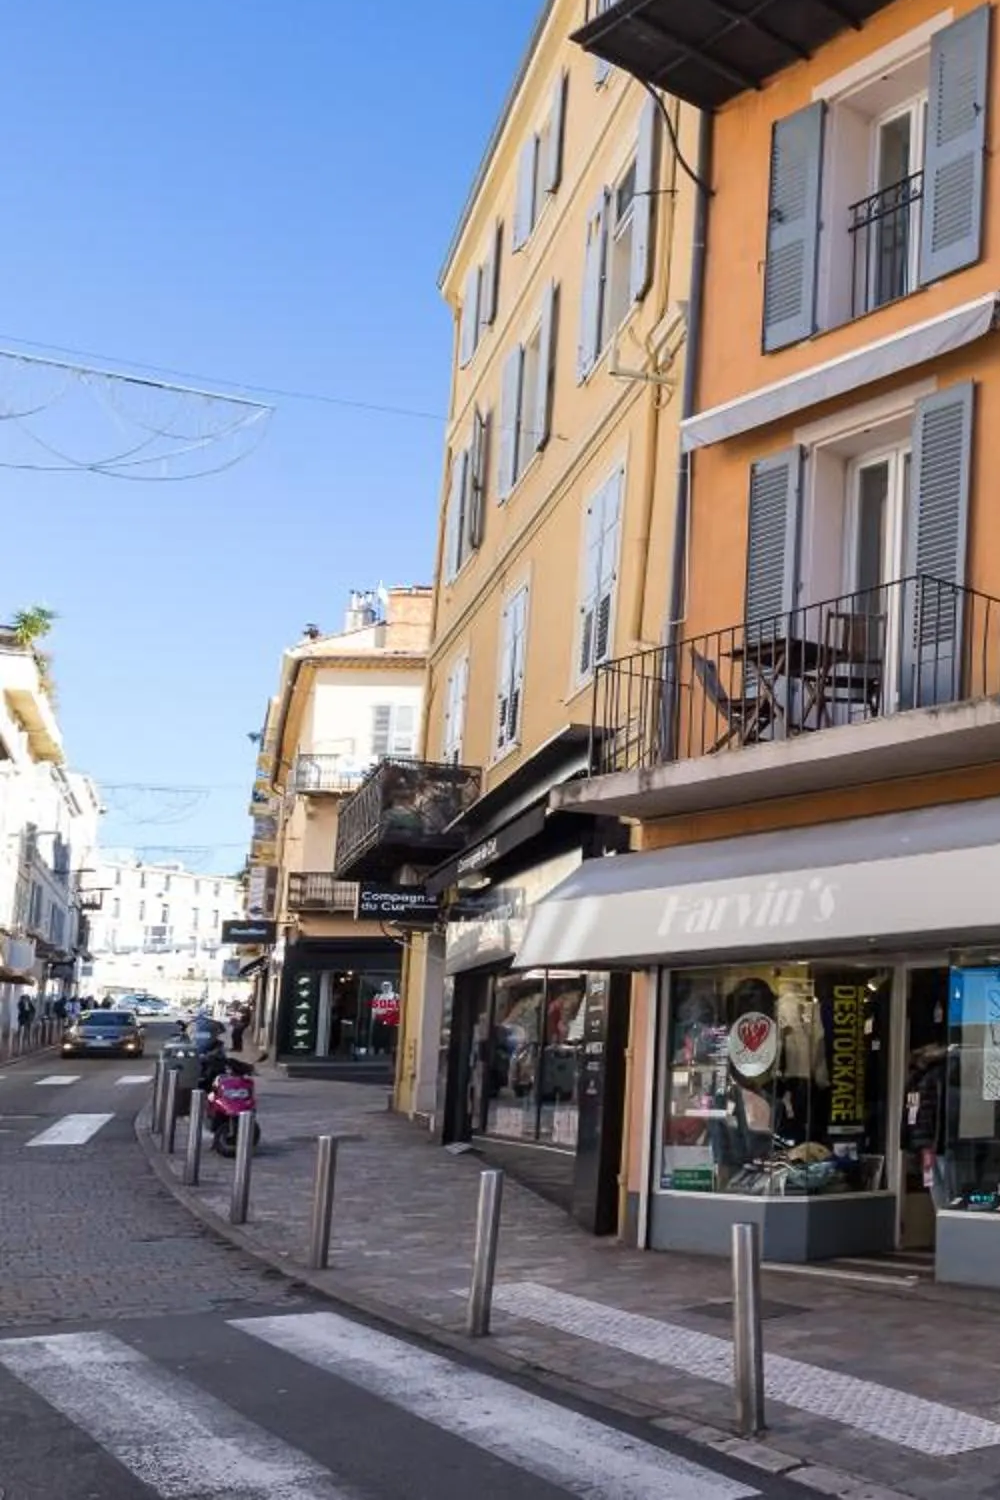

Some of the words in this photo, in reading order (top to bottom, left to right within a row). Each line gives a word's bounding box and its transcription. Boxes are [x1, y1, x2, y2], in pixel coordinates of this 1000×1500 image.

[361, 891, 437, 903] Compagne
[361, 902, 377, 911] du
[831, 984, 856, 1123] DESTOCKAGE
